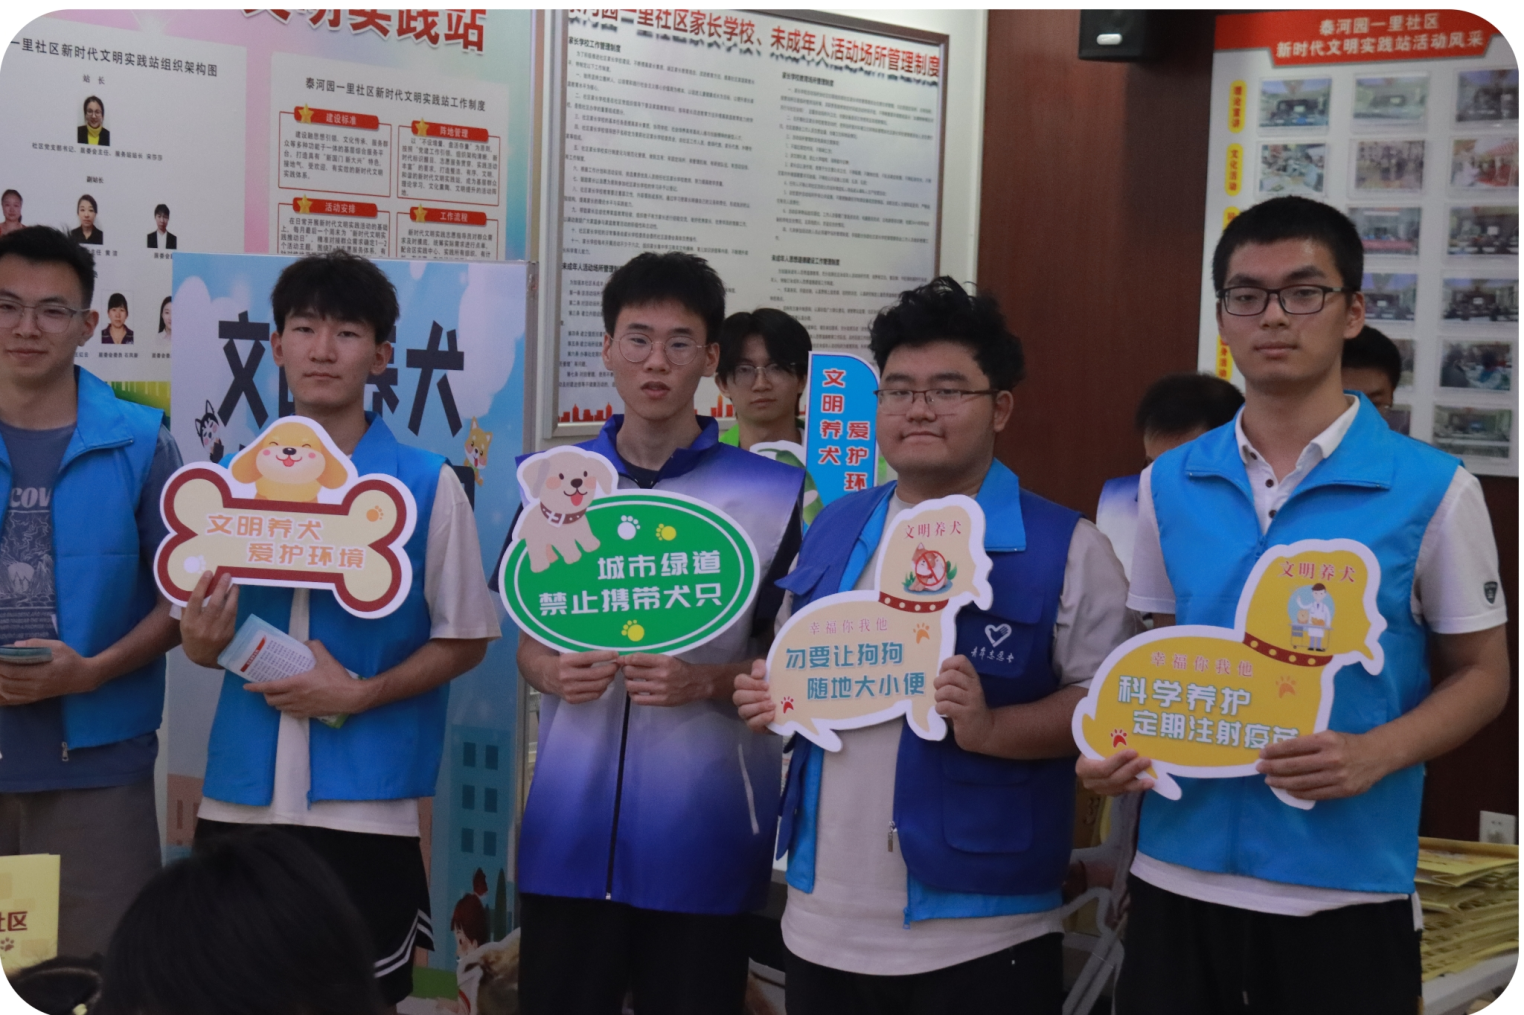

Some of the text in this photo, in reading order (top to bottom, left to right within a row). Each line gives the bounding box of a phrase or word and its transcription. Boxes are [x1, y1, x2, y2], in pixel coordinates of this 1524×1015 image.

[1319, 13, 1439, 35] 泰河园一里社区
[10, 37, 218, 78] 一里社区新时代文明实践站组织架构图
[568, 37, 621, 53] 家长学校工作管理制度
[1276, 31, 1484, 58] 新时代文明实践站活动风采
[305, 77, 486, 112] 泰河园一里社区新时代文明实践站工作制度
[326, 113, 357, 125] 建设标准
[440, 126, 469, 138] 阵地管理
[1229, 149, 1239, 191] 文化活动
[325, 202, 356, 214] 活动安排
[440, 212, 468, 223] 工作流程
[819, 368, 846, 465] 文明养犬
[207, 513, 322, 541] 文明养犬
[903, 520, 962, 540] 文明养犬
[248, 542, 366, 570] 爱护环境
[597, 551, 722, 582] 城市绿道
[1280, 560, 1356, 583] 文明养犬
[538, 584, 723, 618] 禁止携带犬只
[810, 617, 889, 636] 幸福你我他
[786, 641, 904, 669] 勿要让狗狗
[1151, 650, 1254, 677] 幸福你我他
[806, 670, 926, 702] 随地大小便
[1118, 675, 1251, 716] 科学养护
